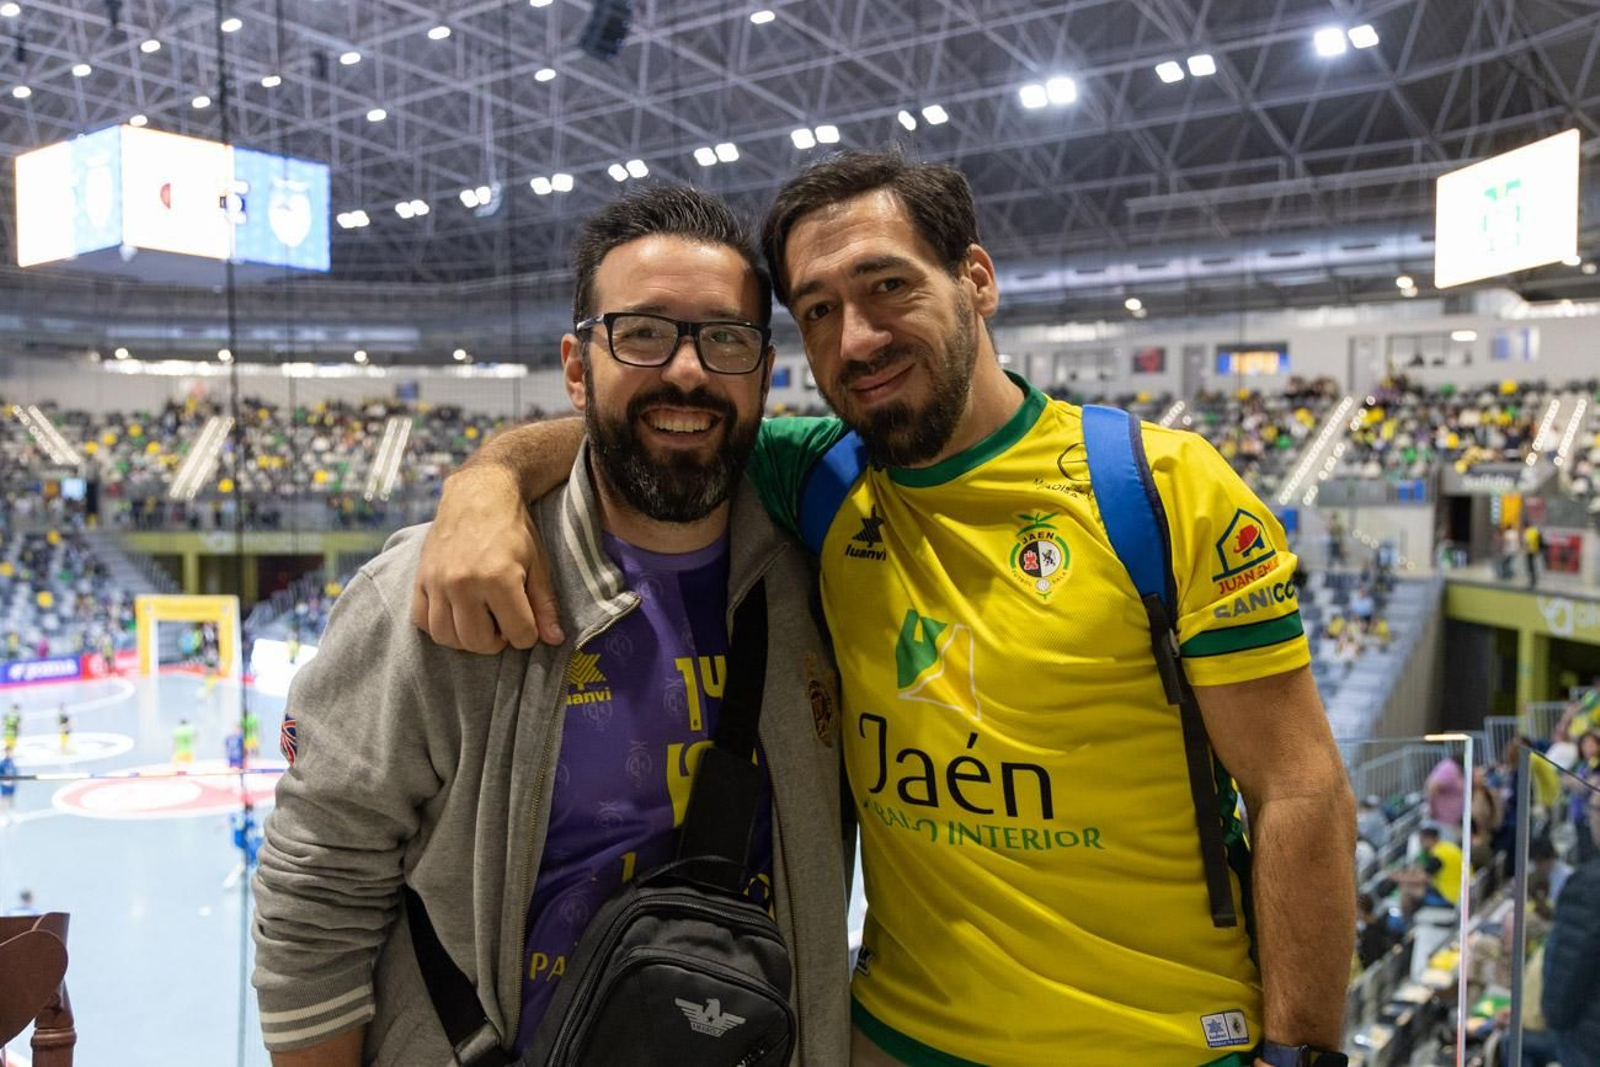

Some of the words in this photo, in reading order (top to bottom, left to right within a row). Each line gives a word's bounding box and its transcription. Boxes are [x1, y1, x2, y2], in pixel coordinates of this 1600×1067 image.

[1022, 531, 1055, 545] JAEN
[1218, 570, 1255, 594] JUAN
[859, 712, 1054, 820] Jaén
[948, 821, 1105, 850] INTERIOR
